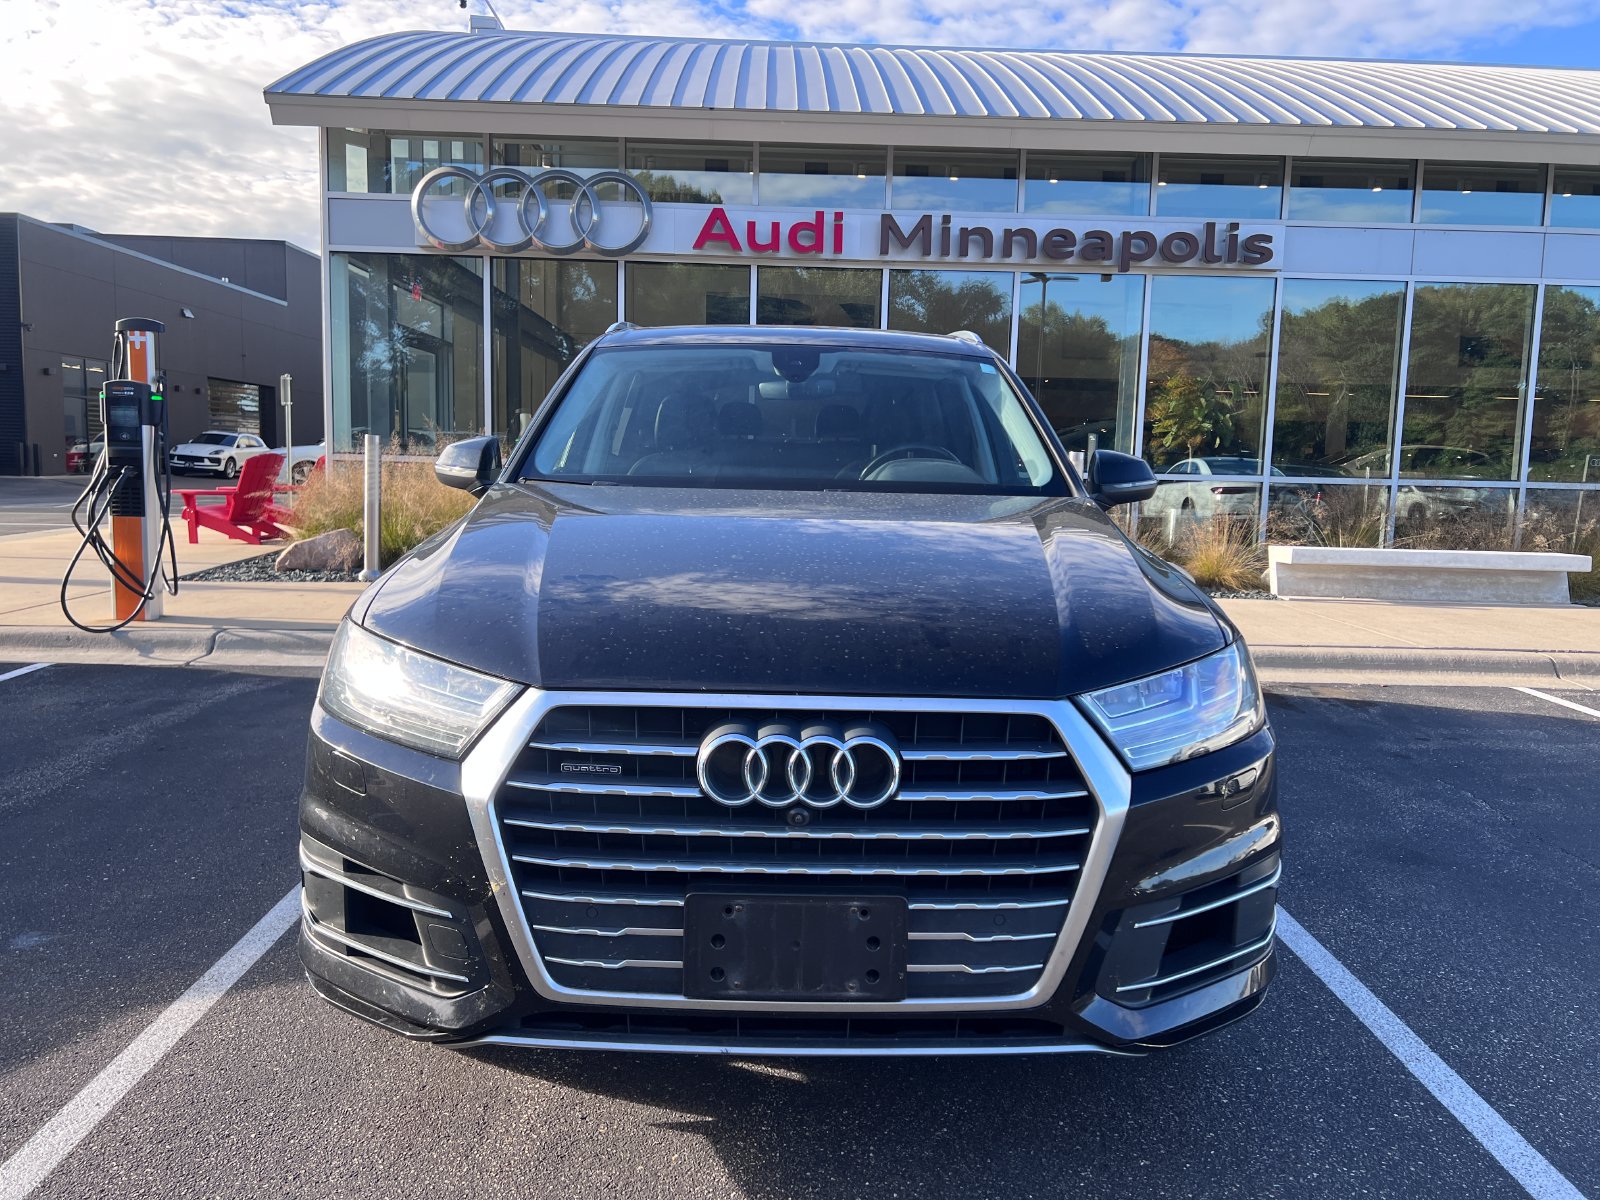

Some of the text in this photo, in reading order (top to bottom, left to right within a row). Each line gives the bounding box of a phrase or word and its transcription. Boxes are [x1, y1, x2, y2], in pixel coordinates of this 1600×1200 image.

[692, 207, 1274, 273] Audi Minneapolis
[563, 764, 619, 774] quattro
